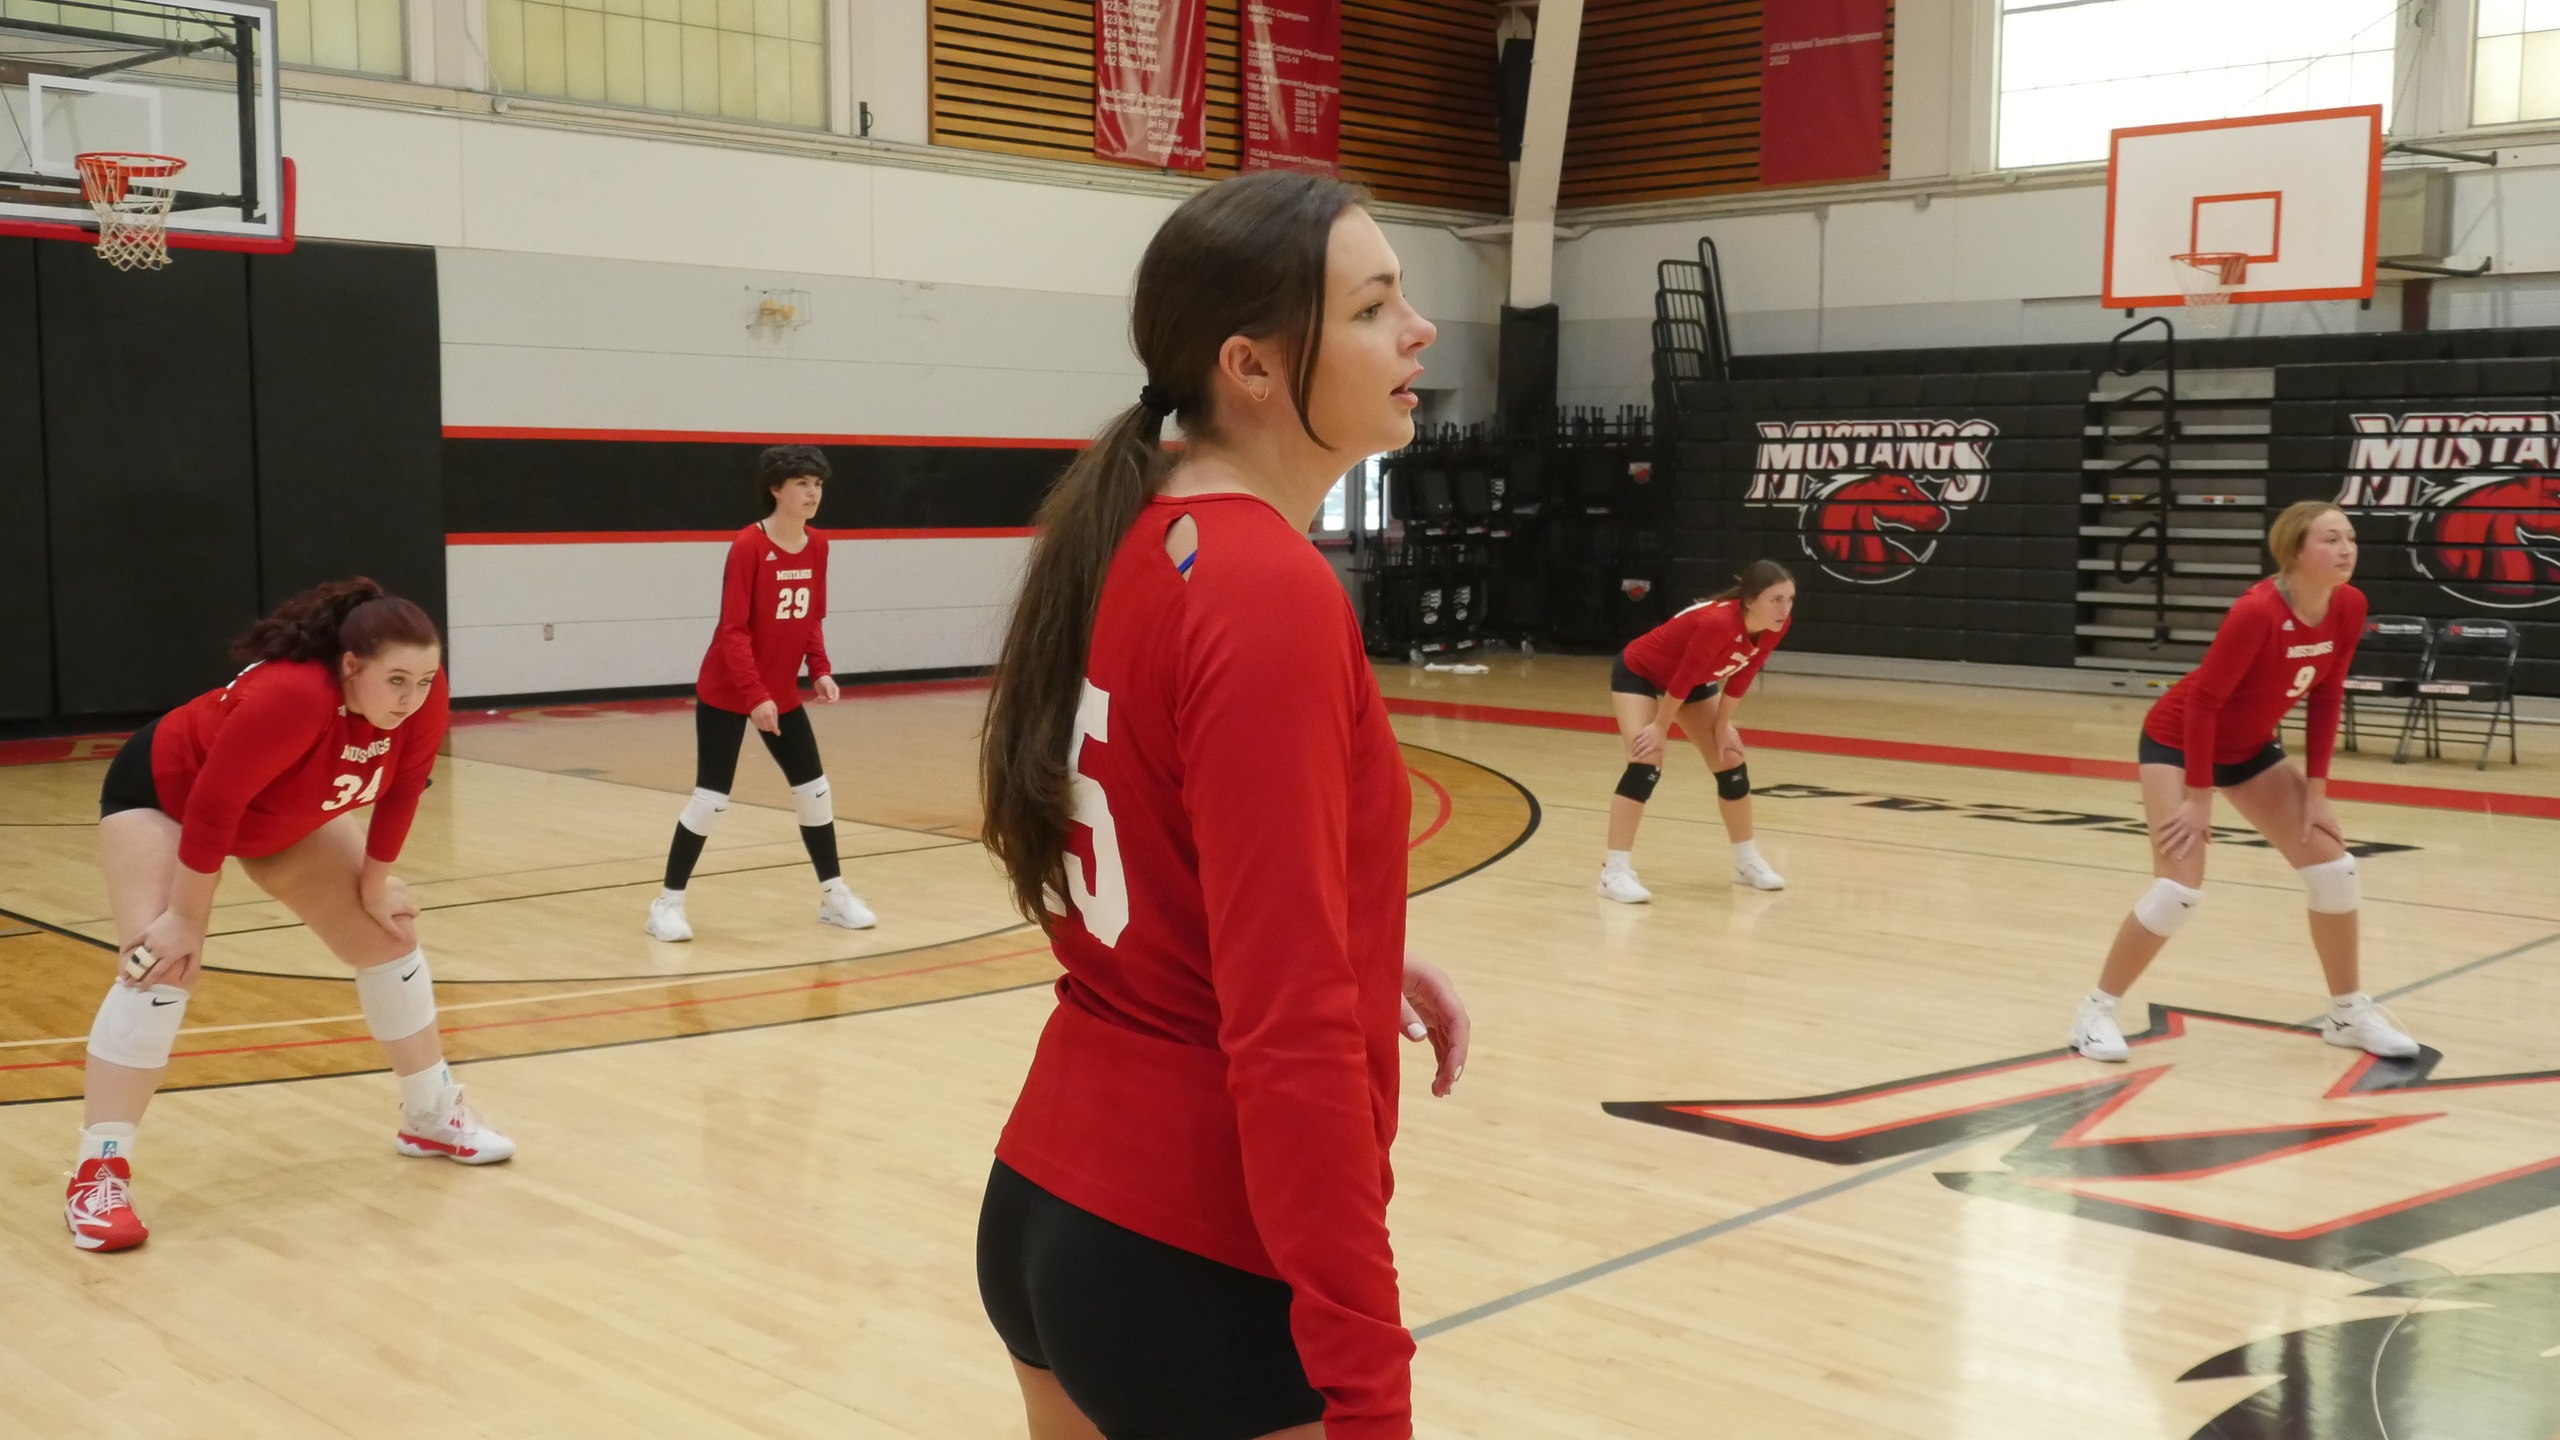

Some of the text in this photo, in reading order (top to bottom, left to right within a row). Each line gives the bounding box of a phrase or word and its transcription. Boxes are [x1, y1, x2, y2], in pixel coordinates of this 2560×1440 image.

[1746, 419, 1999, 509] MUSTANGS
[2336, 412, 2560, 515] MUSTA
[775, 587, 810, 620] 29
[2285, 665, 2316, 698] 9
[321, 766, 384, 811] 34
[1042, 677, 1130, 949] 5
